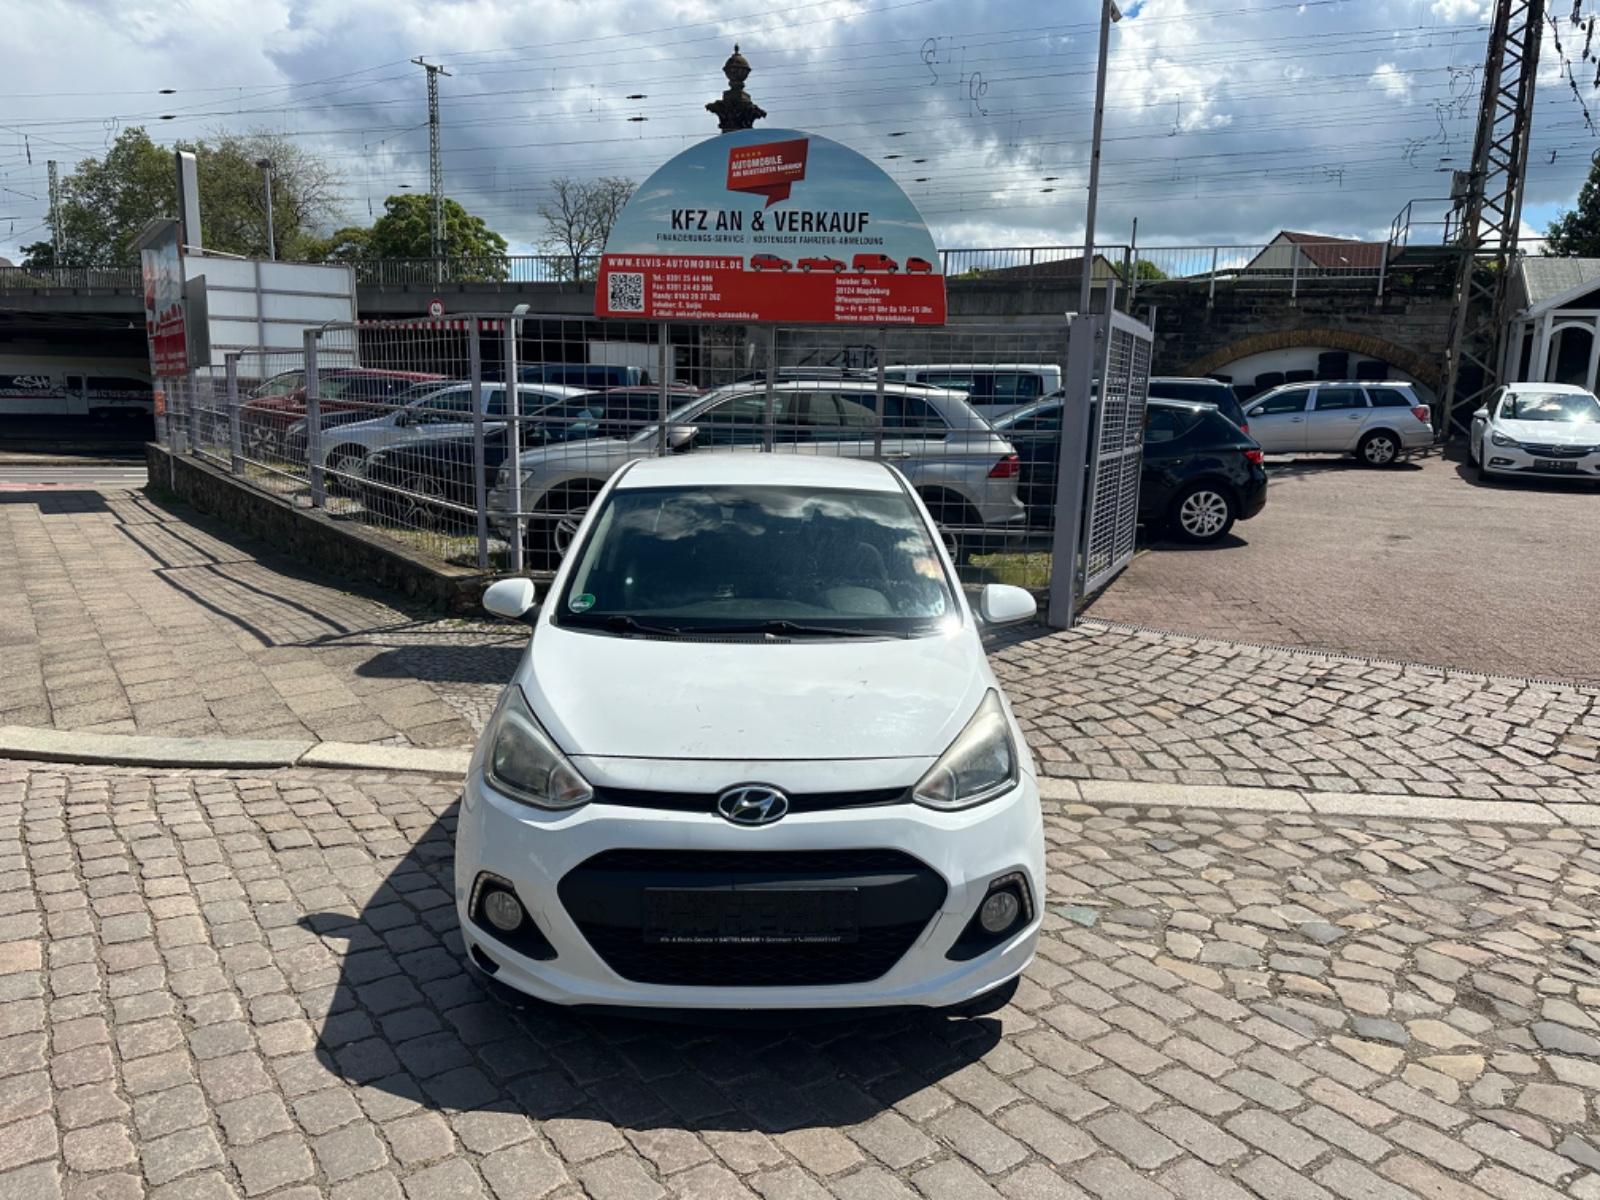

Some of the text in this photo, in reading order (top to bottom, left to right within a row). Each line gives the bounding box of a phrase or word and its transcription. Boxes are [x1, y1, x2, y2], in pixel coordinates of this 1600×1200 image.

[732, 155, 783, 170] AUTOMOBILE
[672, 209, 870, 233] KFZ AN & VERKAUF
[753, 235, 797, 244] KOSTENLOSE
[856, 287, 890, 297] Magdeburg
